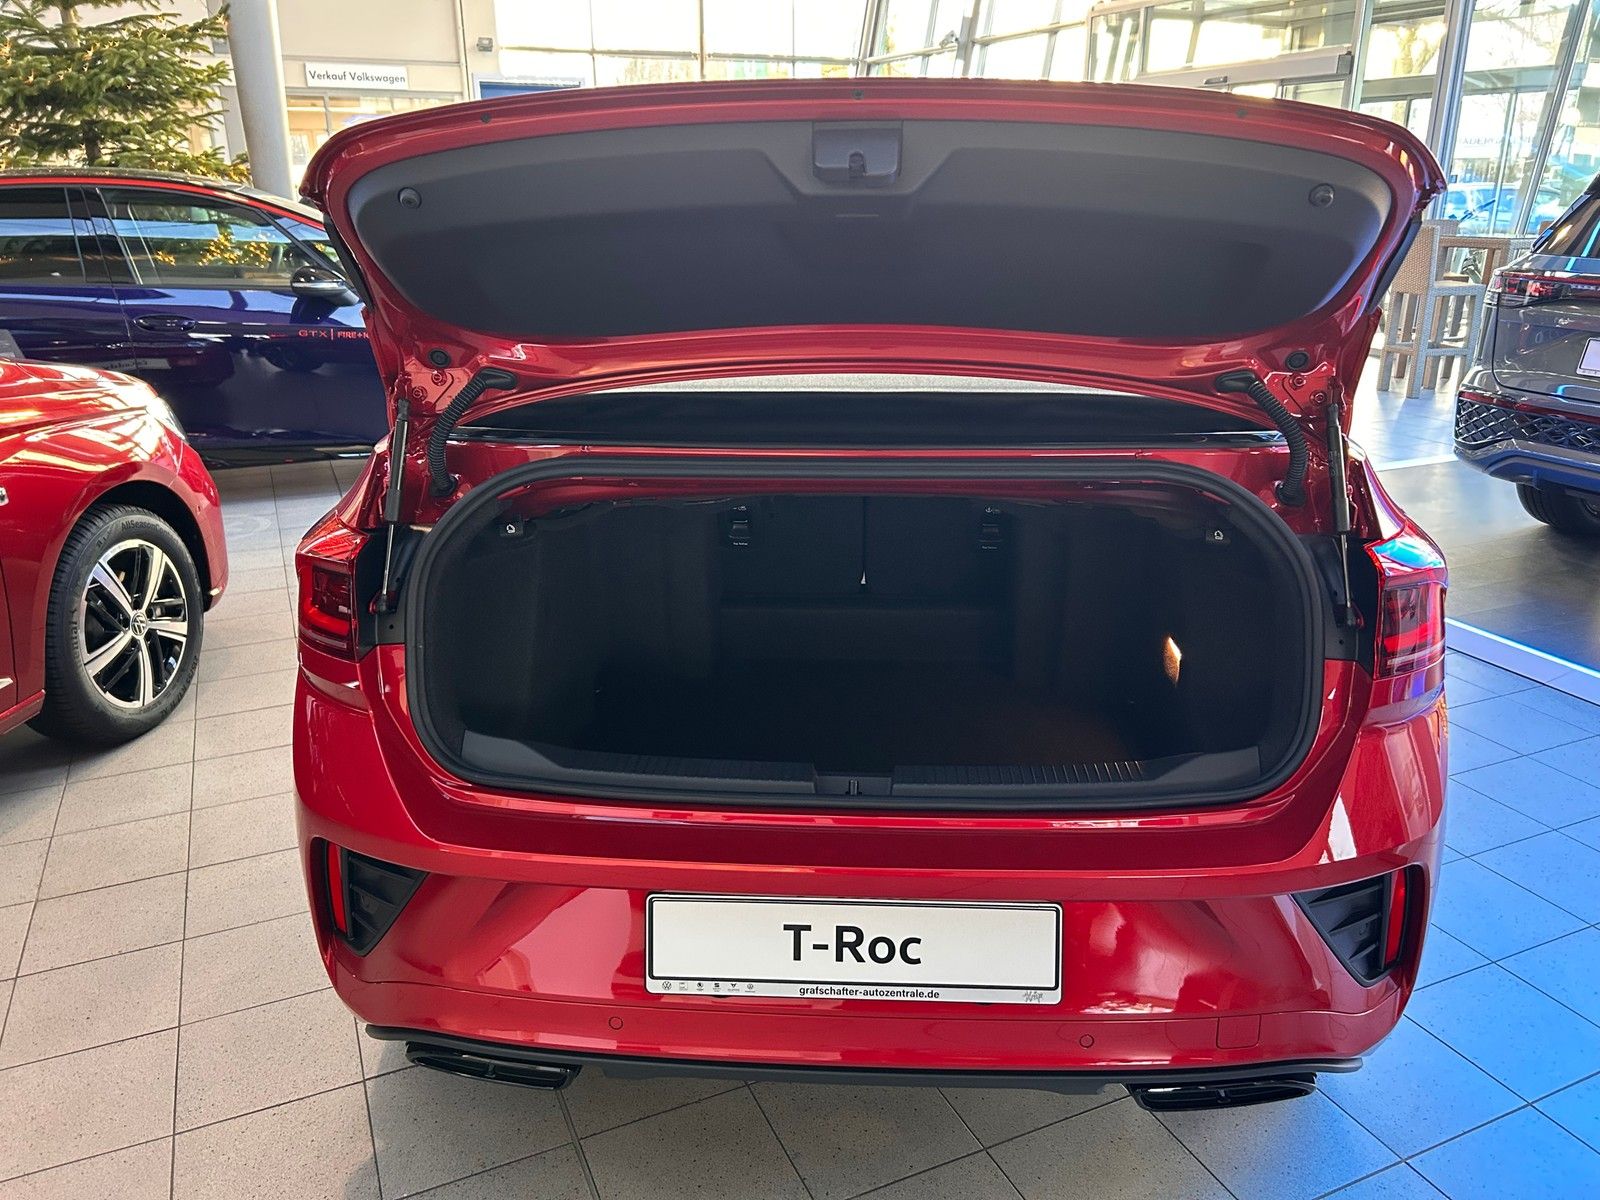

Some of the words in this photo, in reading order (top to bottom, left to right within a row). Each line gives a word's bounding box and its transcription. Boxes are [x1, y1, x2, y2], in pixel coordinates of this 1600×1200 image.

[308, 70, 347, 81] Verkauf
[348, 71, 406, 85] Volkswagen
[298, 329, 328, 338] GTX
[783, 924, 922, 964] T-Roc
[799, 985, 940, 999] grafschafter-autozentrale.de
